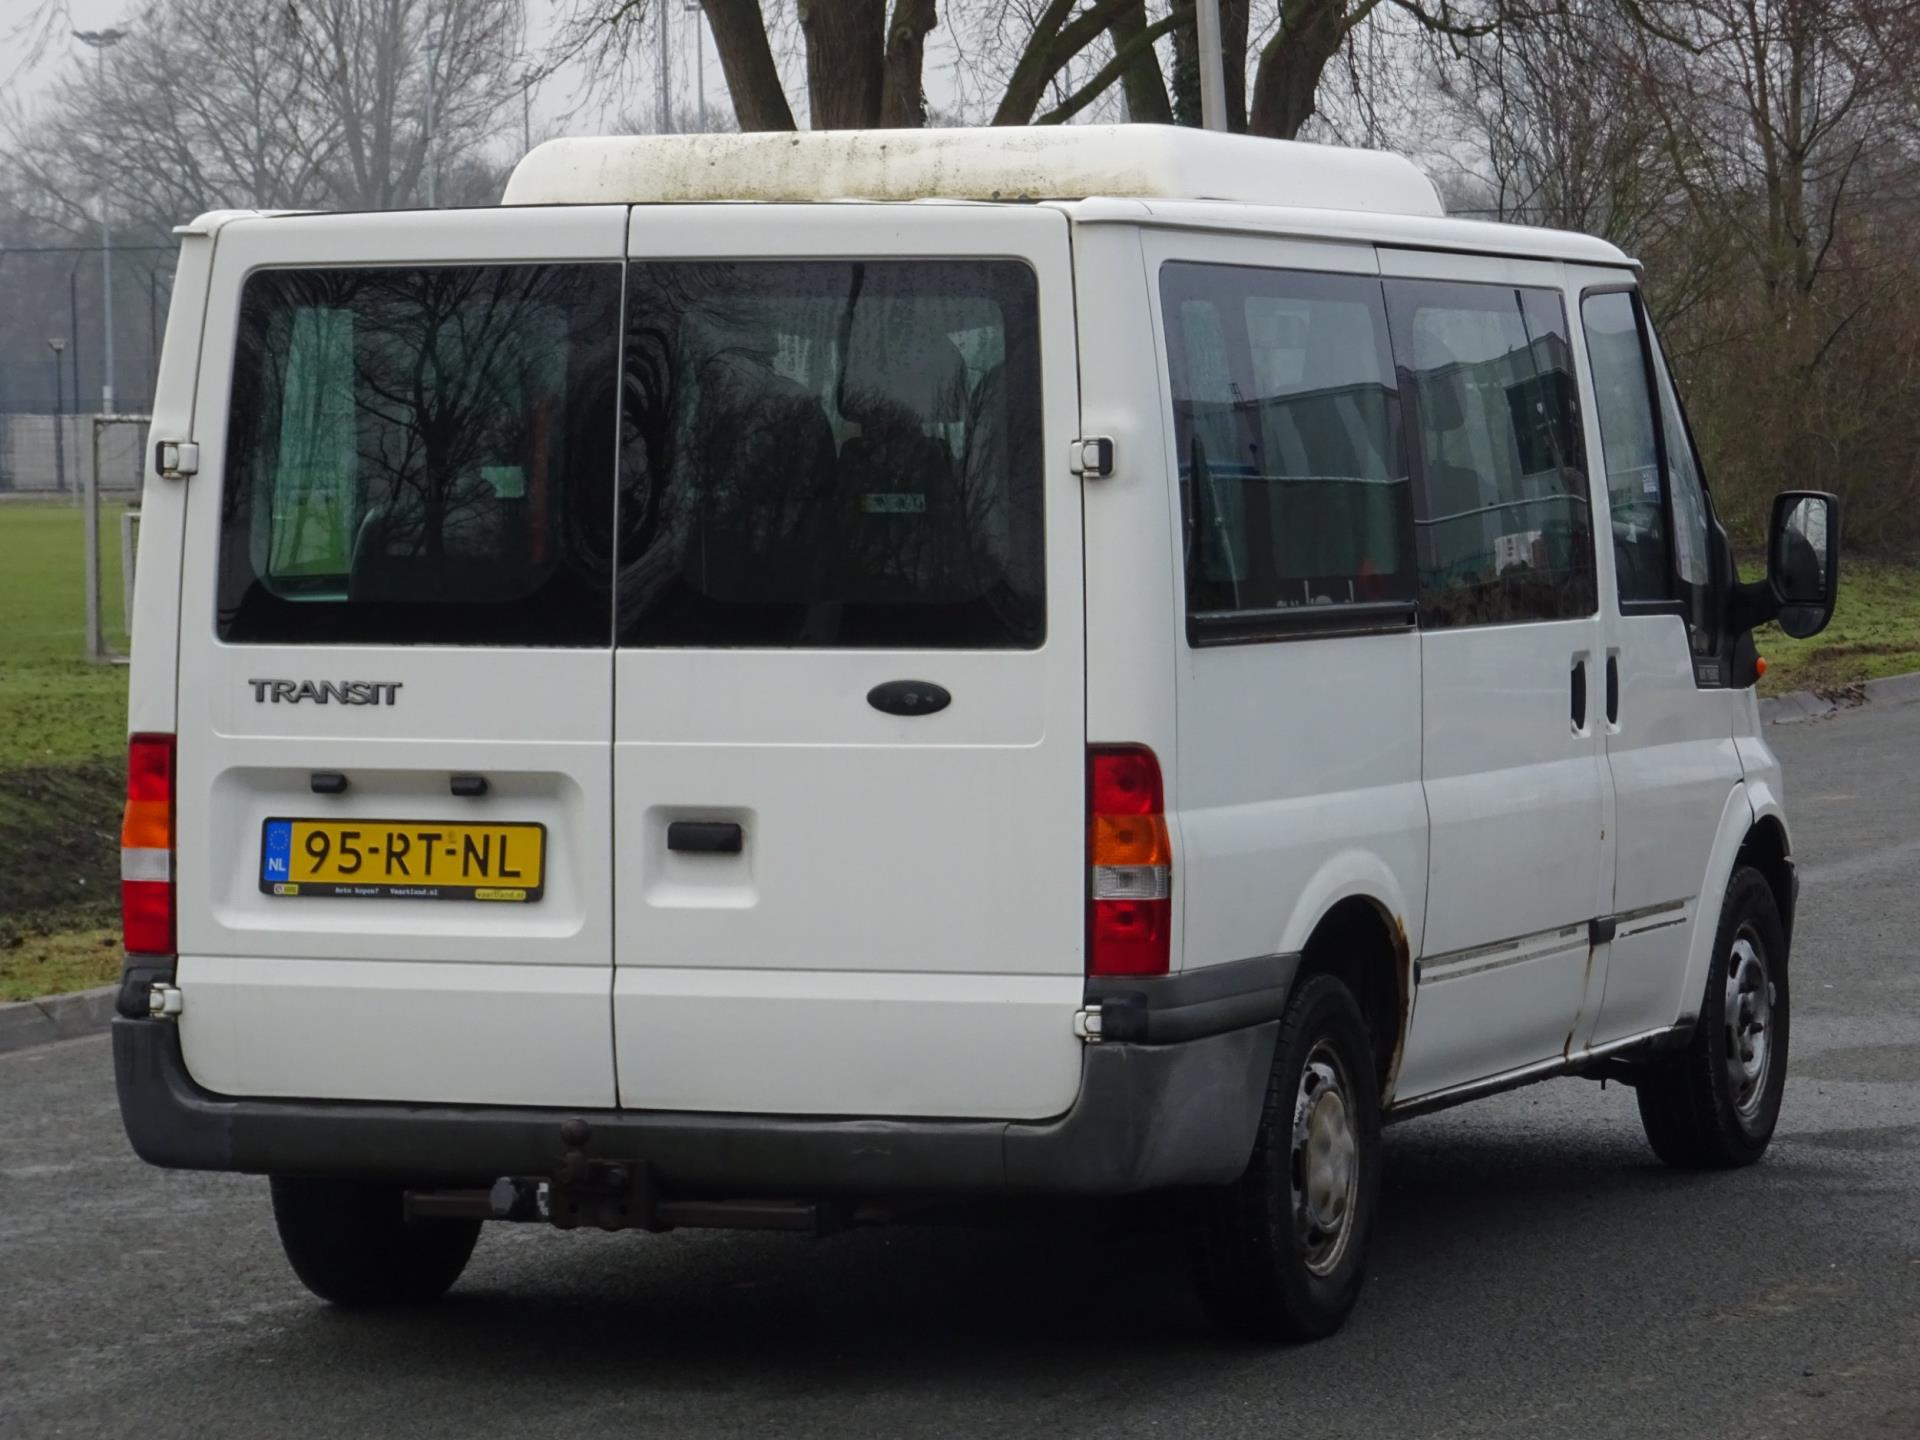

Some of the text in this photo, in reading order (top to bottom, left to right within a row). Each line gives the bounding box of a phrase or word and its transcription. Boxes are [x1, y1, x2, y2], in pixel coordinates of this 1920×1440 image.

[248, 679, 403, 706] TRANSIT
[268, 857, 286, 872] NL
[304, 829, 522, 878] 95-RT-NL
